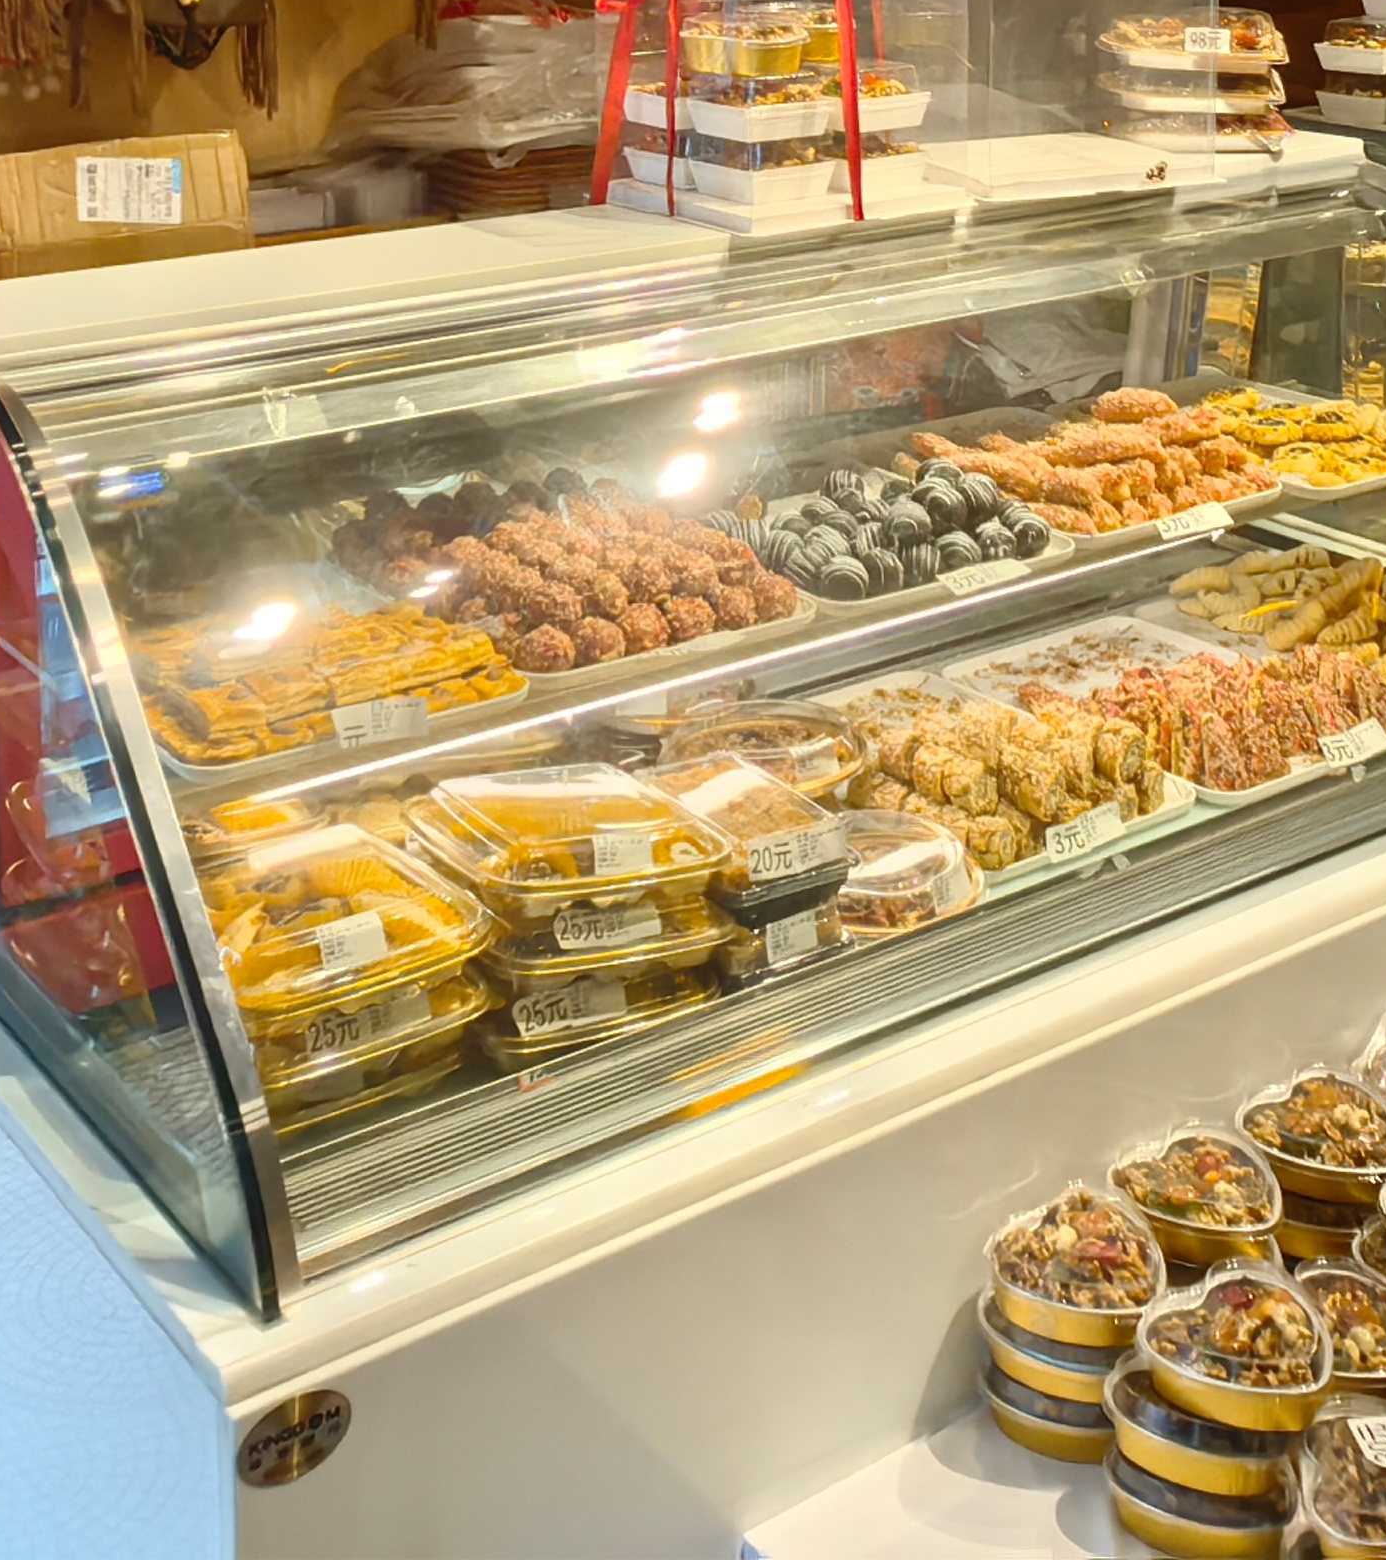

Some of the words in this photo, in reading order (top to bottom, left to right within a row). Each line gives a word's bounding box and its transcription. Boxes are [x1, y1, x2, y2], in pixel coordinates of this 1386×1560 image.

[1322, 739, 1354, 761] 3元
[1053, 825, 1085, 855] 3元
[751, 843, 793, 875] 20元
[559, 913, 606, 942] 25元
[518, 995, 568, 1033] 25元
[308, 1015, 360, 1054] 25元
